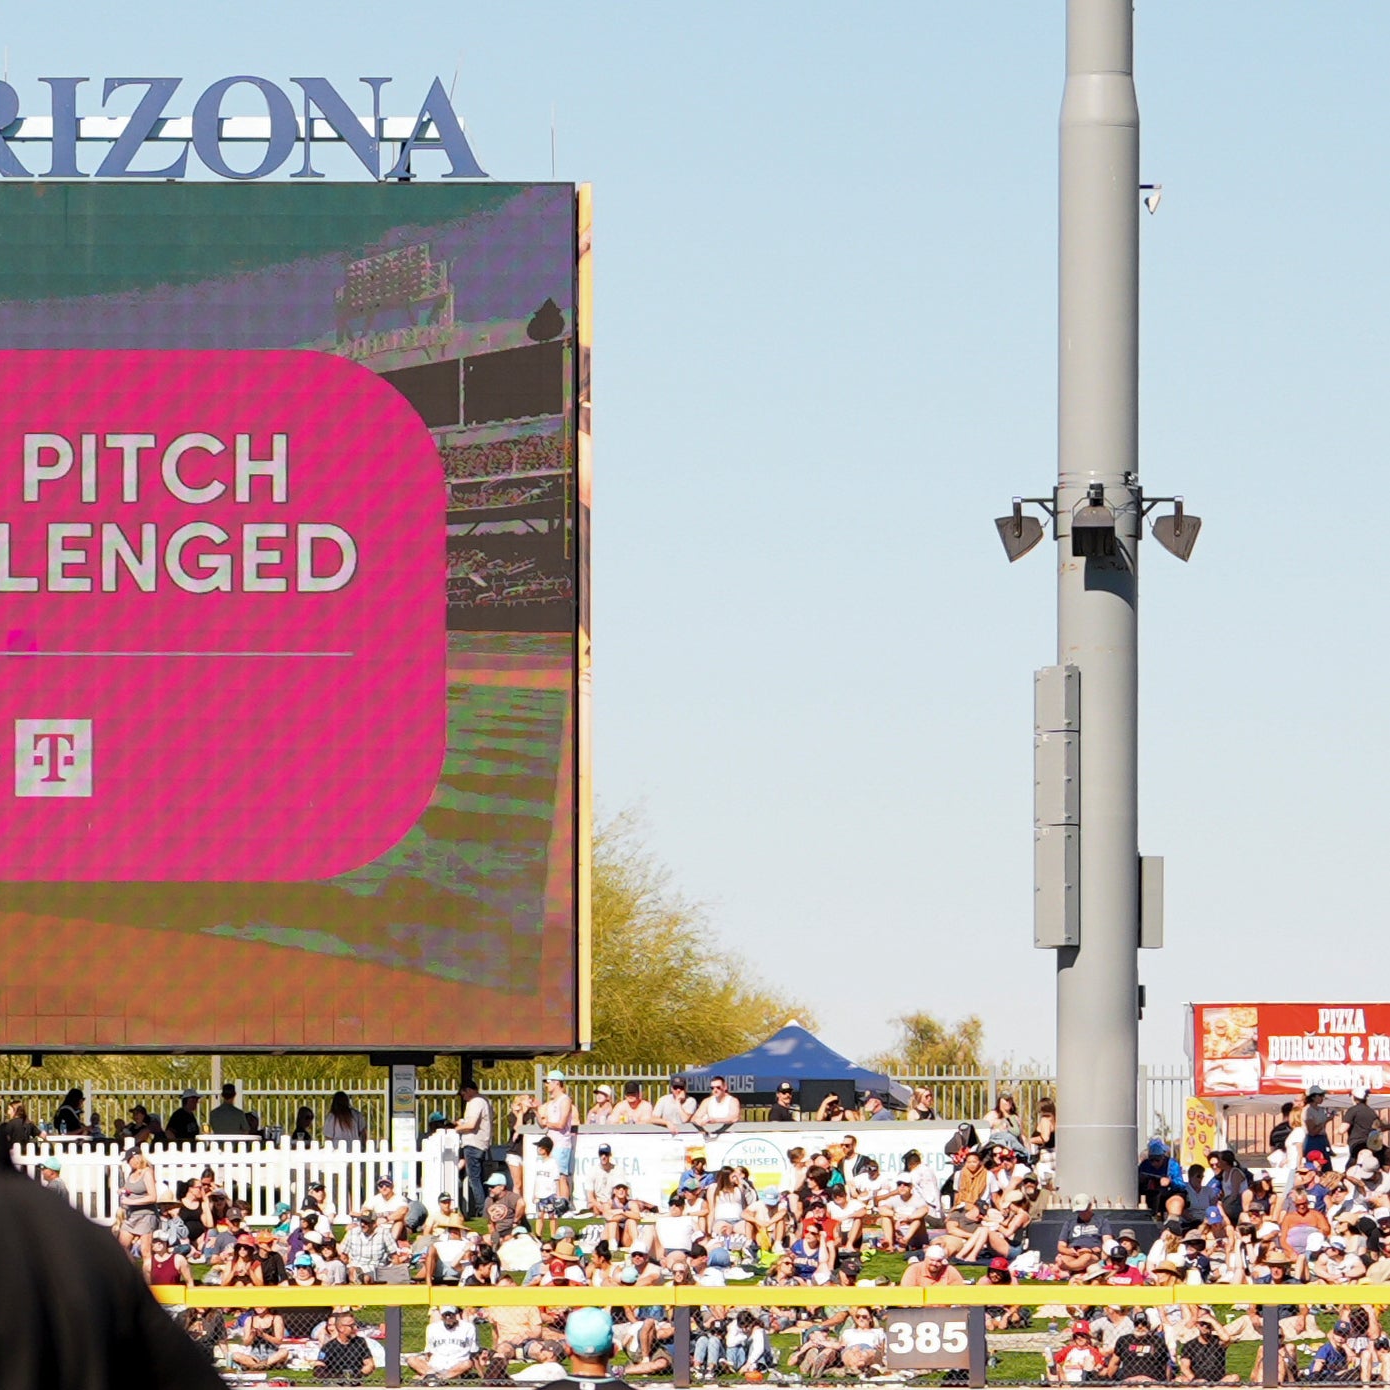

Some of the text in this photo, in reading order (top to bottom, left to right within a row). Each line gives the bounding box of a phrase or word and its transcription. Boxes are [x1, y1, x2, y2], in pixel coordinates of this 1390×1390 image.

[23, 431, 290, 504] PITCH
[1318, 1008, 1366, 1034] PIZZA
[1268, 1034, 1346, 1062] BURGERS
[729, 1157, 778, 1166] CRUISER
[888, 1321, 969, 1354] 385
